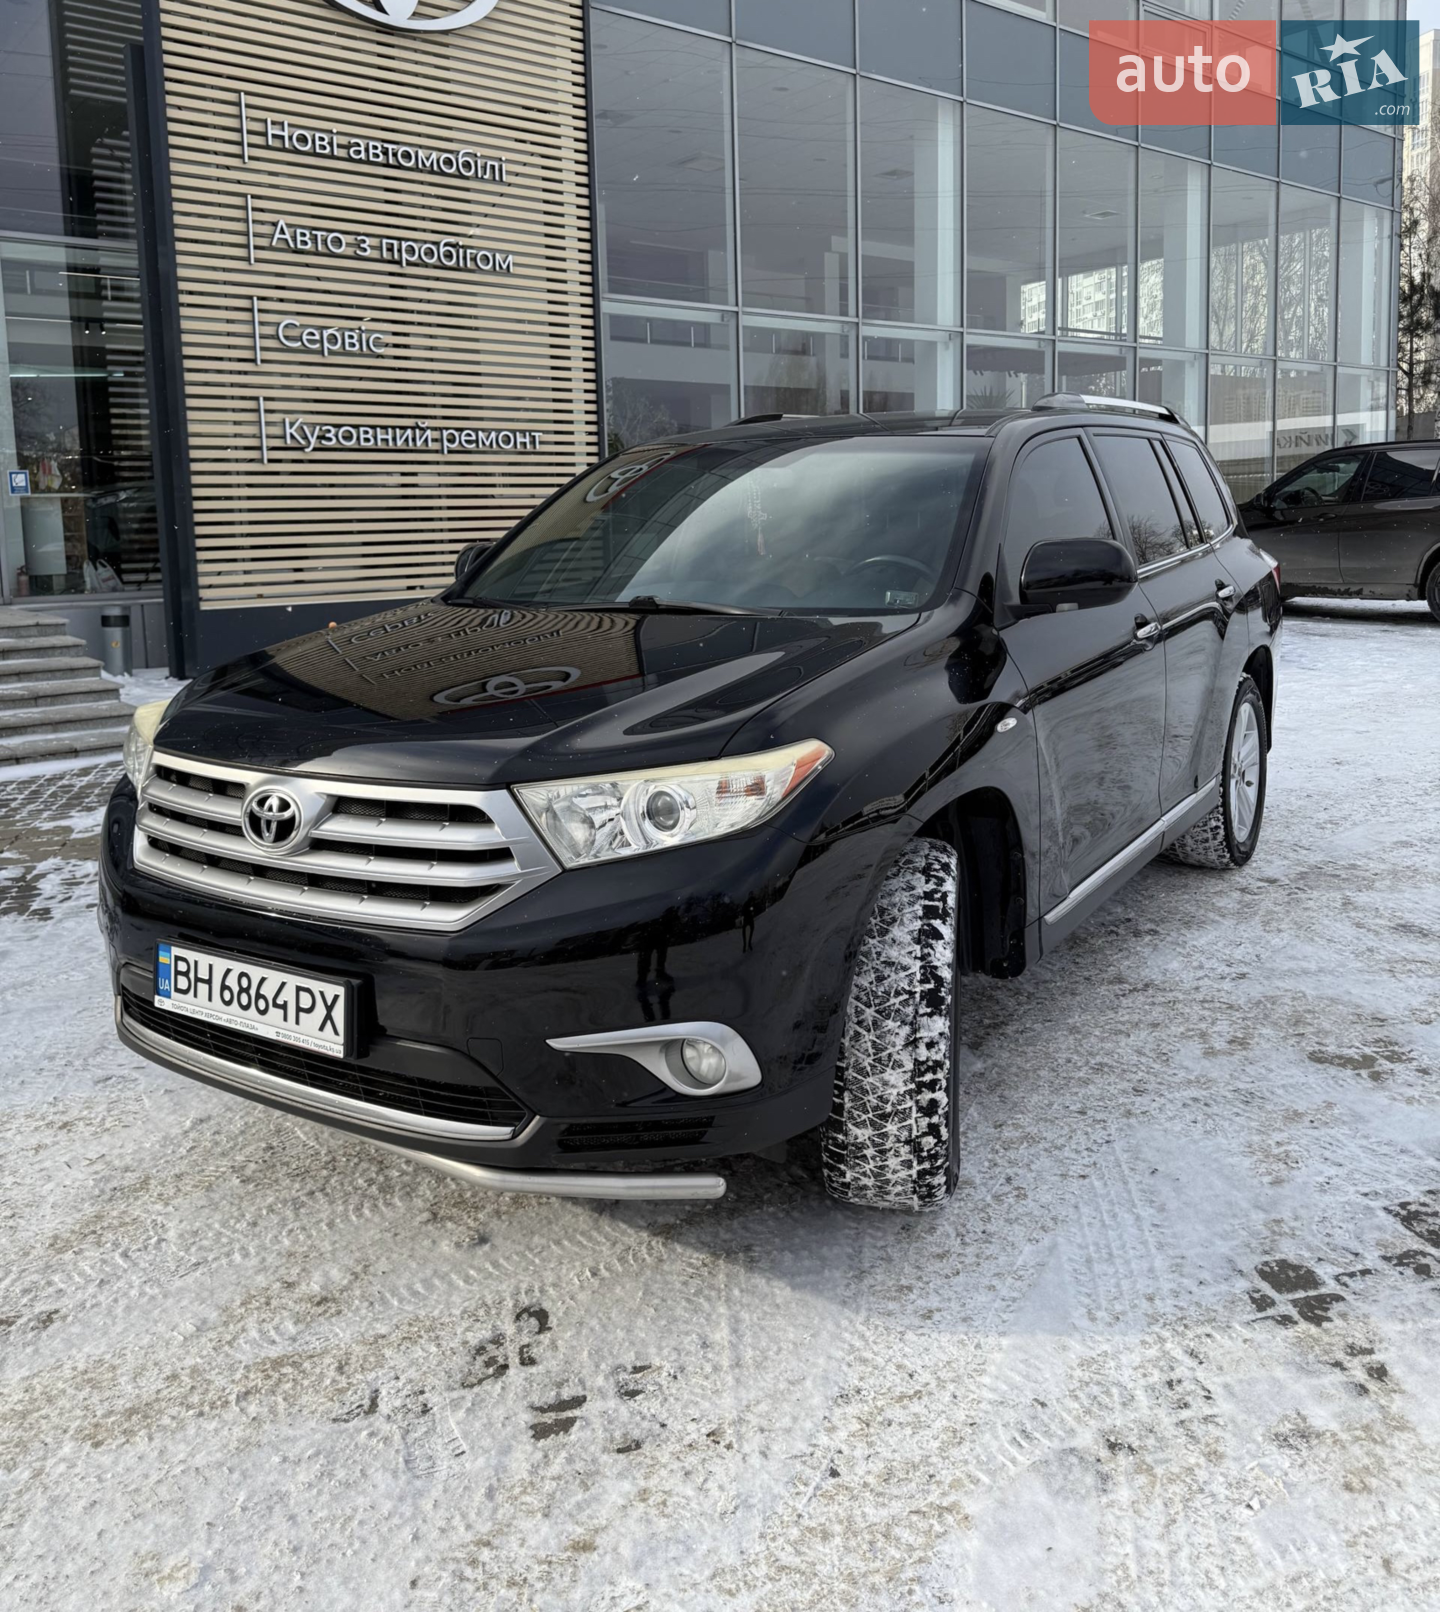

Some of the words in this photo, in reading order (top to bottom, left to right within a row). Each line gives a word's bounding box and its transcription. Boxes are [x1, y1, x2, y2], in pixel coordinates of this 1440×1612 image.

[266, 117, 338, 156] Нові
[348, 138, 507, 182] автомобілі
[271, 219, 346, 254] Авто
[356, 234, 371, 257] з
[381, 237, 515, 273] пробігом
[277, 319, 386, 357] Сервіс
[283, 417, 432, 452] Кузовний
[441, 429, 543, 455] ремонт
[158, 977, 171, 992] UA
